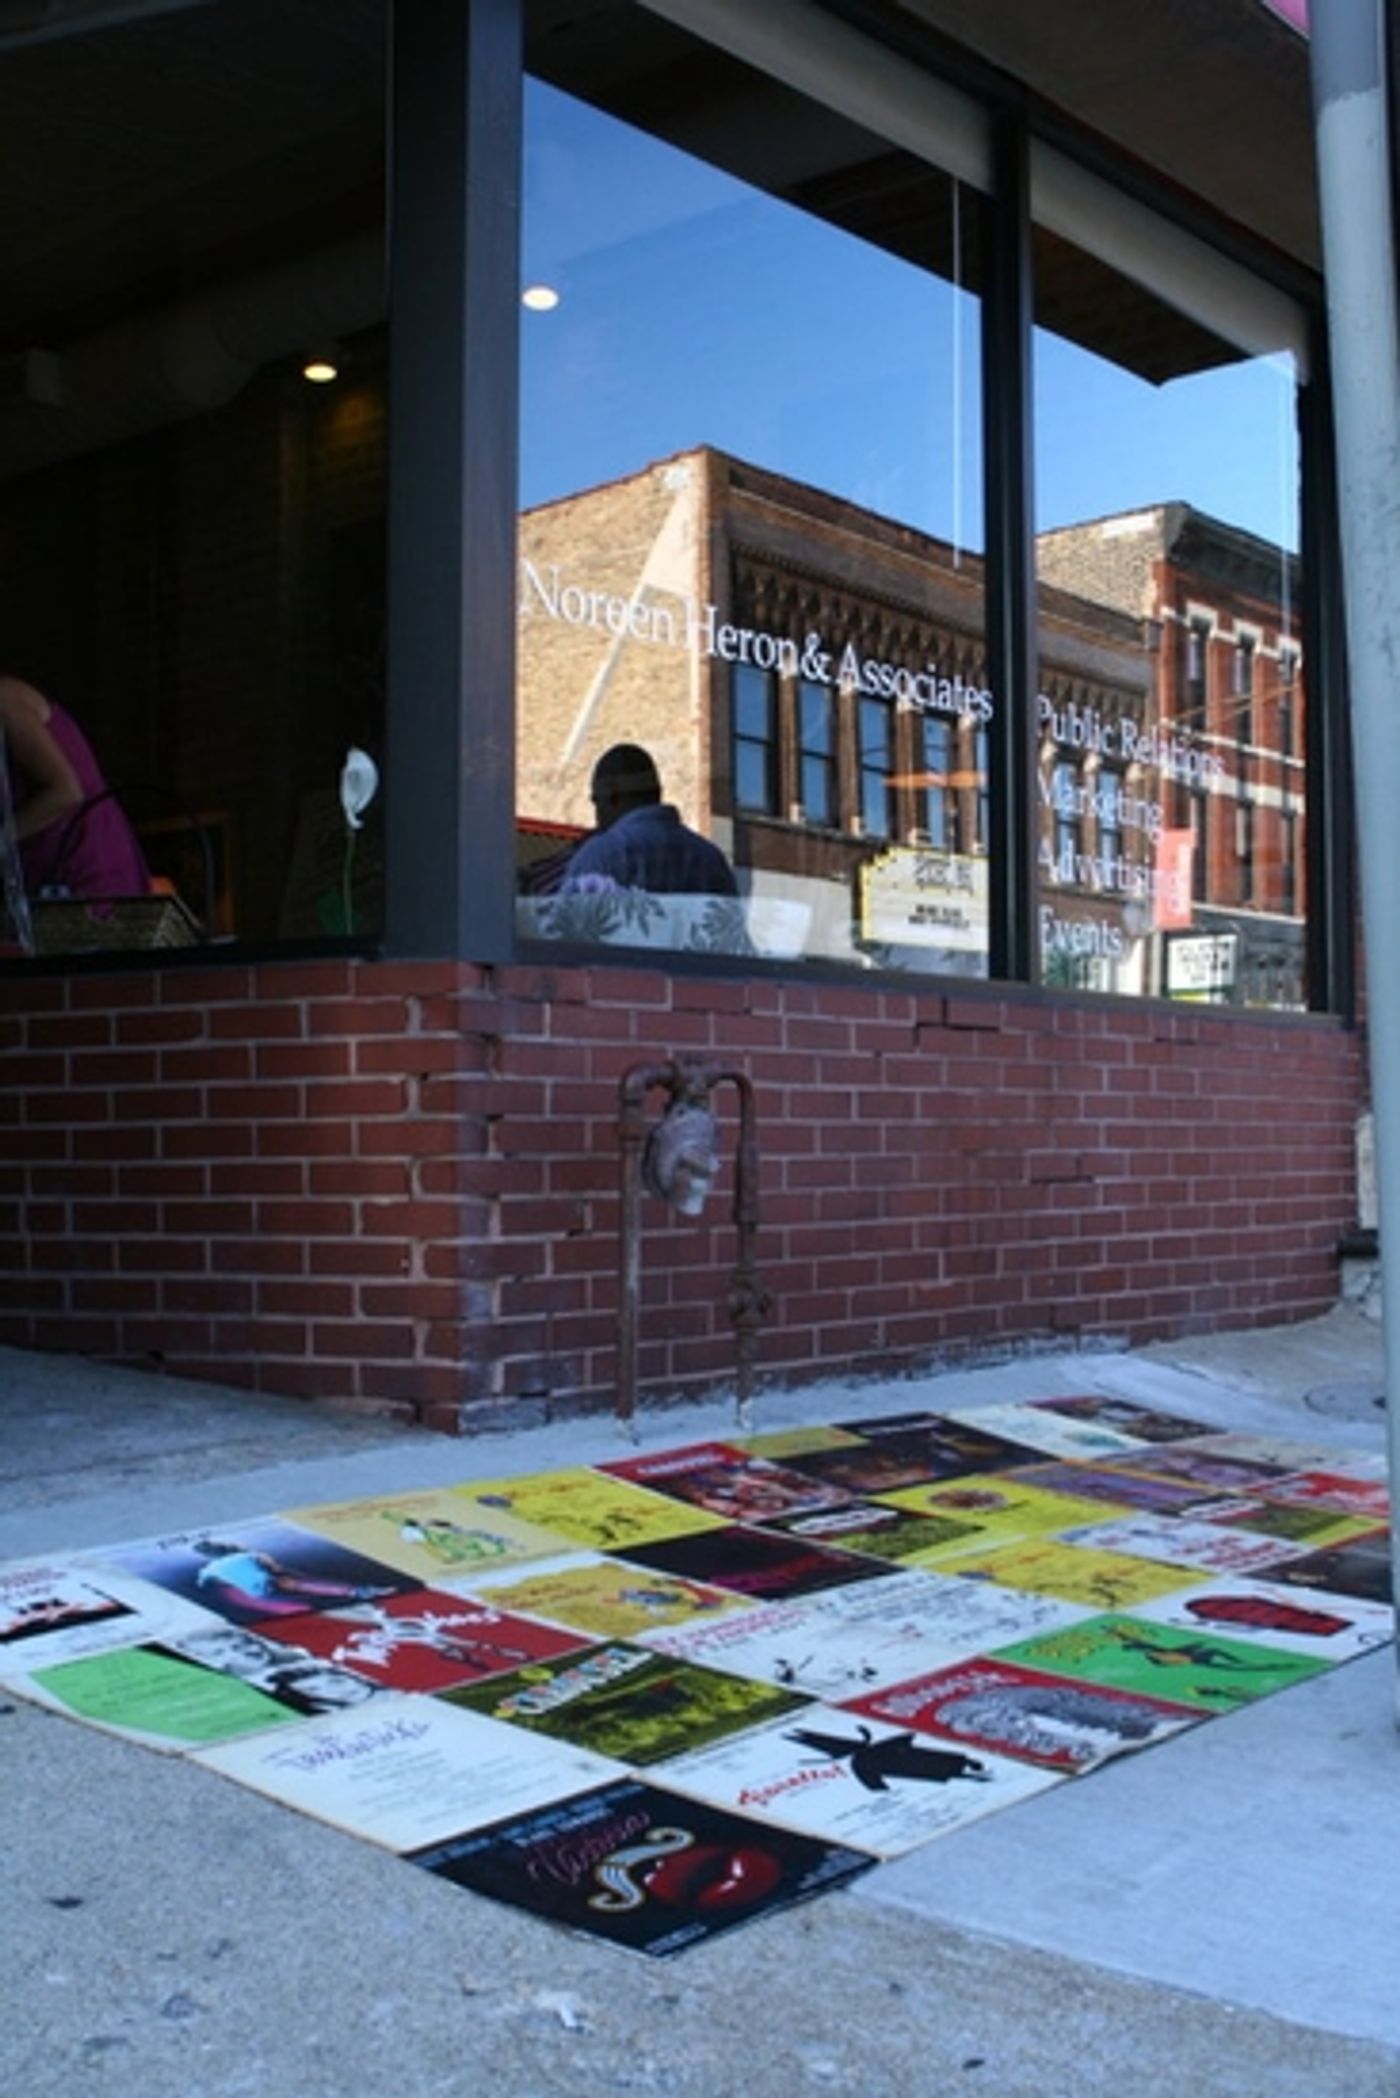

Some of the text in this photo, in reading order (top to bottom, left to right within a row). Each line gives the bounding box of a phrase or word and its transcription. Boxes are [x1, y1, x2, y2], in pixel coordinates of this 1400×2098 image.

[518, 558, 994, 722] Noreen Heron & Associates
[1037, 694, 1113, 754] Public
[1038, 904, 1122, 957] Events
